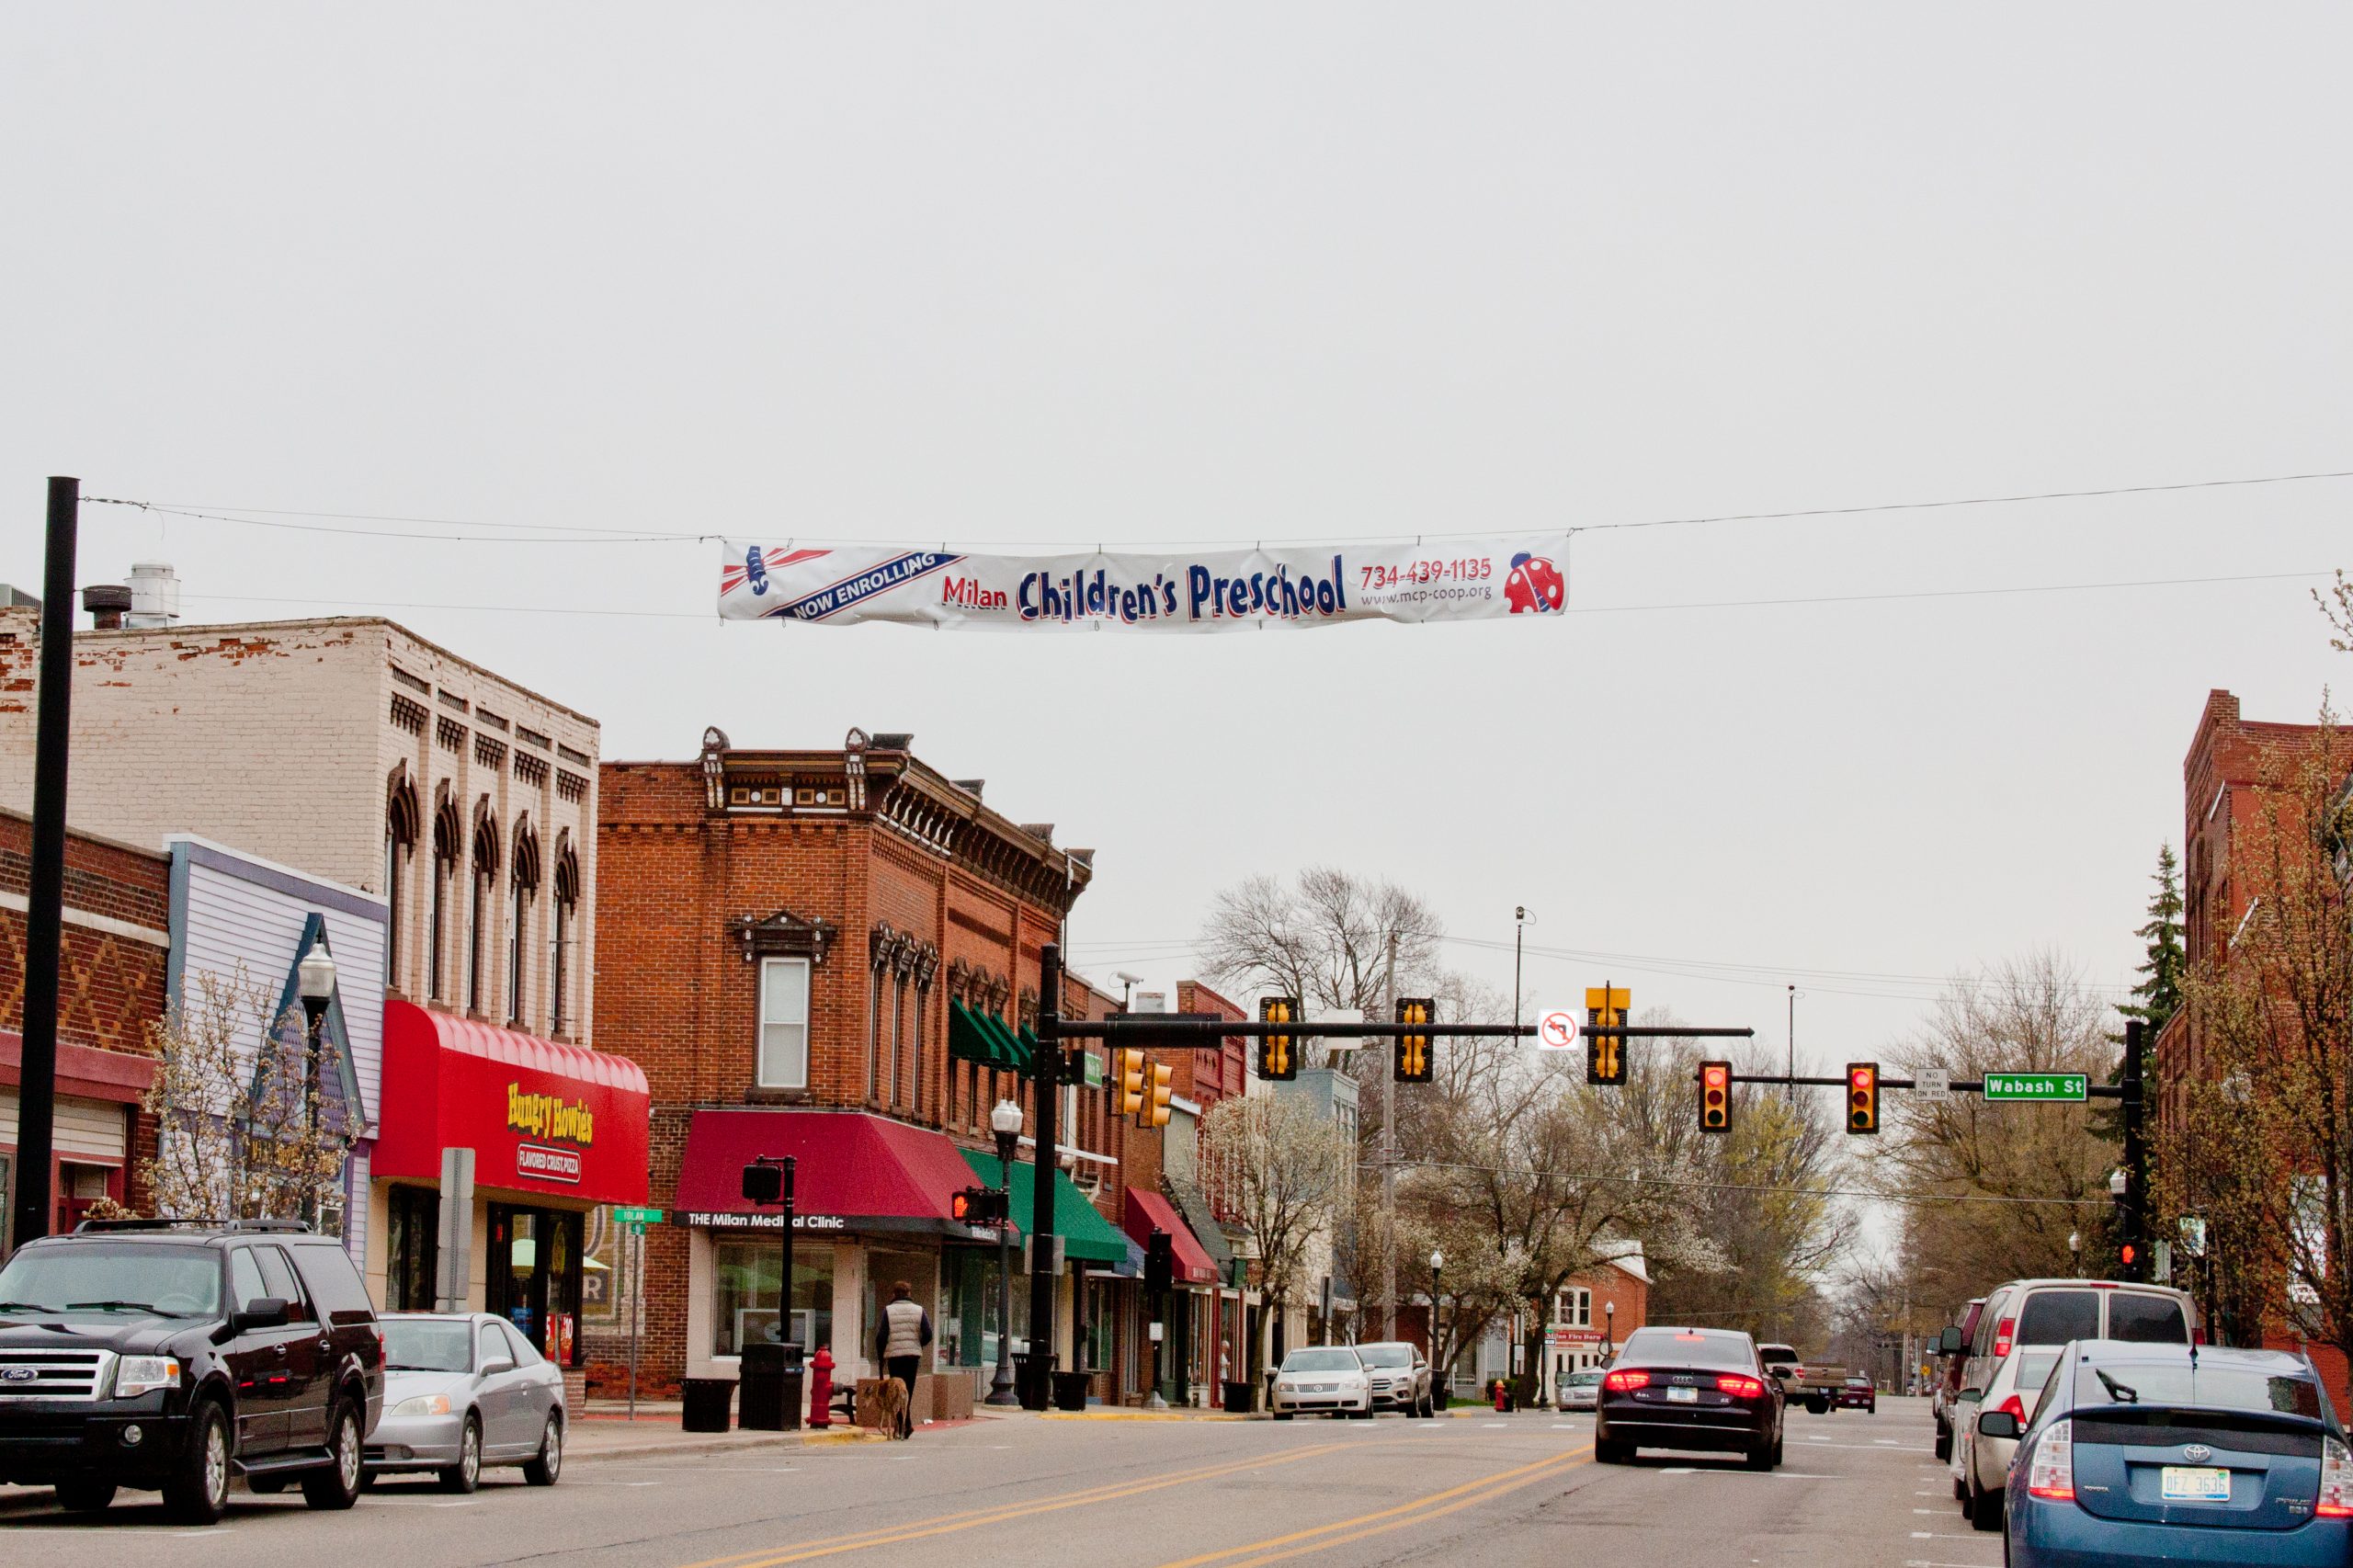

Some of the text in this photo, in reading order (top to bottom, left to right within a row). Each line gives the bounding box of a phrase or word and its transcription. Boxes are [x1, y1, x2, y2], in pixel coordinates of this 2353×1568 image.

[793, 552, 936, 619] NOW ENROLLING
[1361, 558, 1492, 590] 734-439-1135
[942, 554, 1347, 624] Milan Children's Preschool
[1361, 585, 1492, 606] www.mcp-coop.org
[1990, 1079, 2083, 1093] Wabash St
[507, 1082, 593, 1146] Hungry Howie's
[518, 1150, 547, 1170] FLAVORED
[563, 1157, 579, 1175] PIZZA
[689, 1213, 845, 1229] THE Milan Medial Clinic
[2196, 1476, 2225, 1493] 3636
